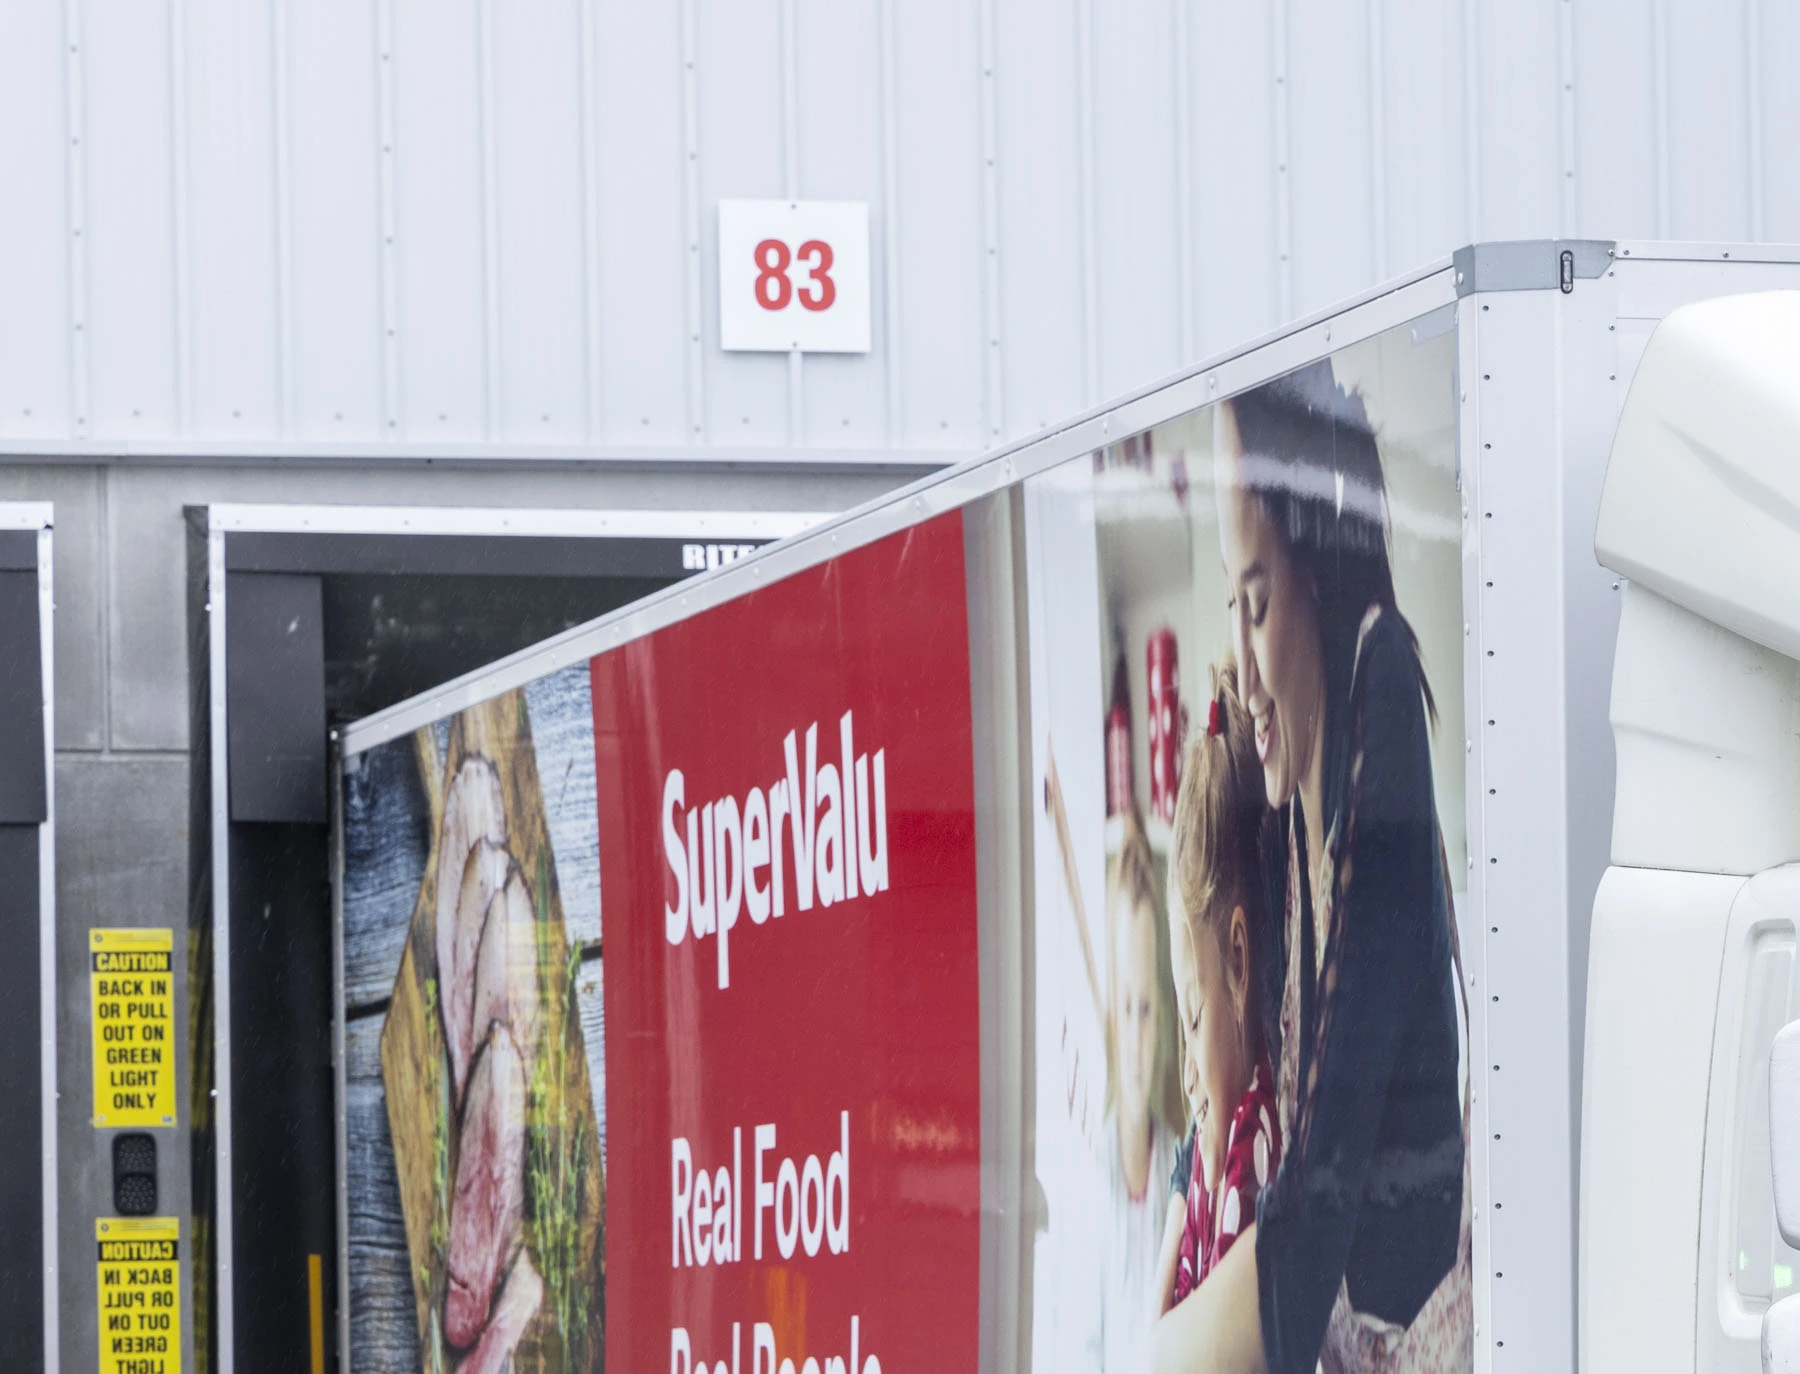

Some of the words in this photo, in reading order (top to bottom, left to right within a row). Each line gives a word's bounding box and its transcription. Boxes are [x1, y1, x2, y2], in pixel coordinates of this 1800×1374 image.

[753, 238, 837, 312] 83
[662, 709, 890, 990] SuperValu
[96, 952, 168, 971] CAUTION
[98, 980, 144, 996] BACK
[151, 980, 166, 996] IN
[98, 1003, 120, 1019] OR
[127, 1003, 168, 1018] PULL
[103, 1025, 135, 1041] OUT
[142, 1025, 164, 1041] ON
[106, 1048, 162, 1064] GREEN
[110, 1070, 158, 1086] LIGHT
[113, 1093, 157, 1109] ONLY
[671, 1125, 742, 1270] Real
[753, 1110, 851, 1261] Food
